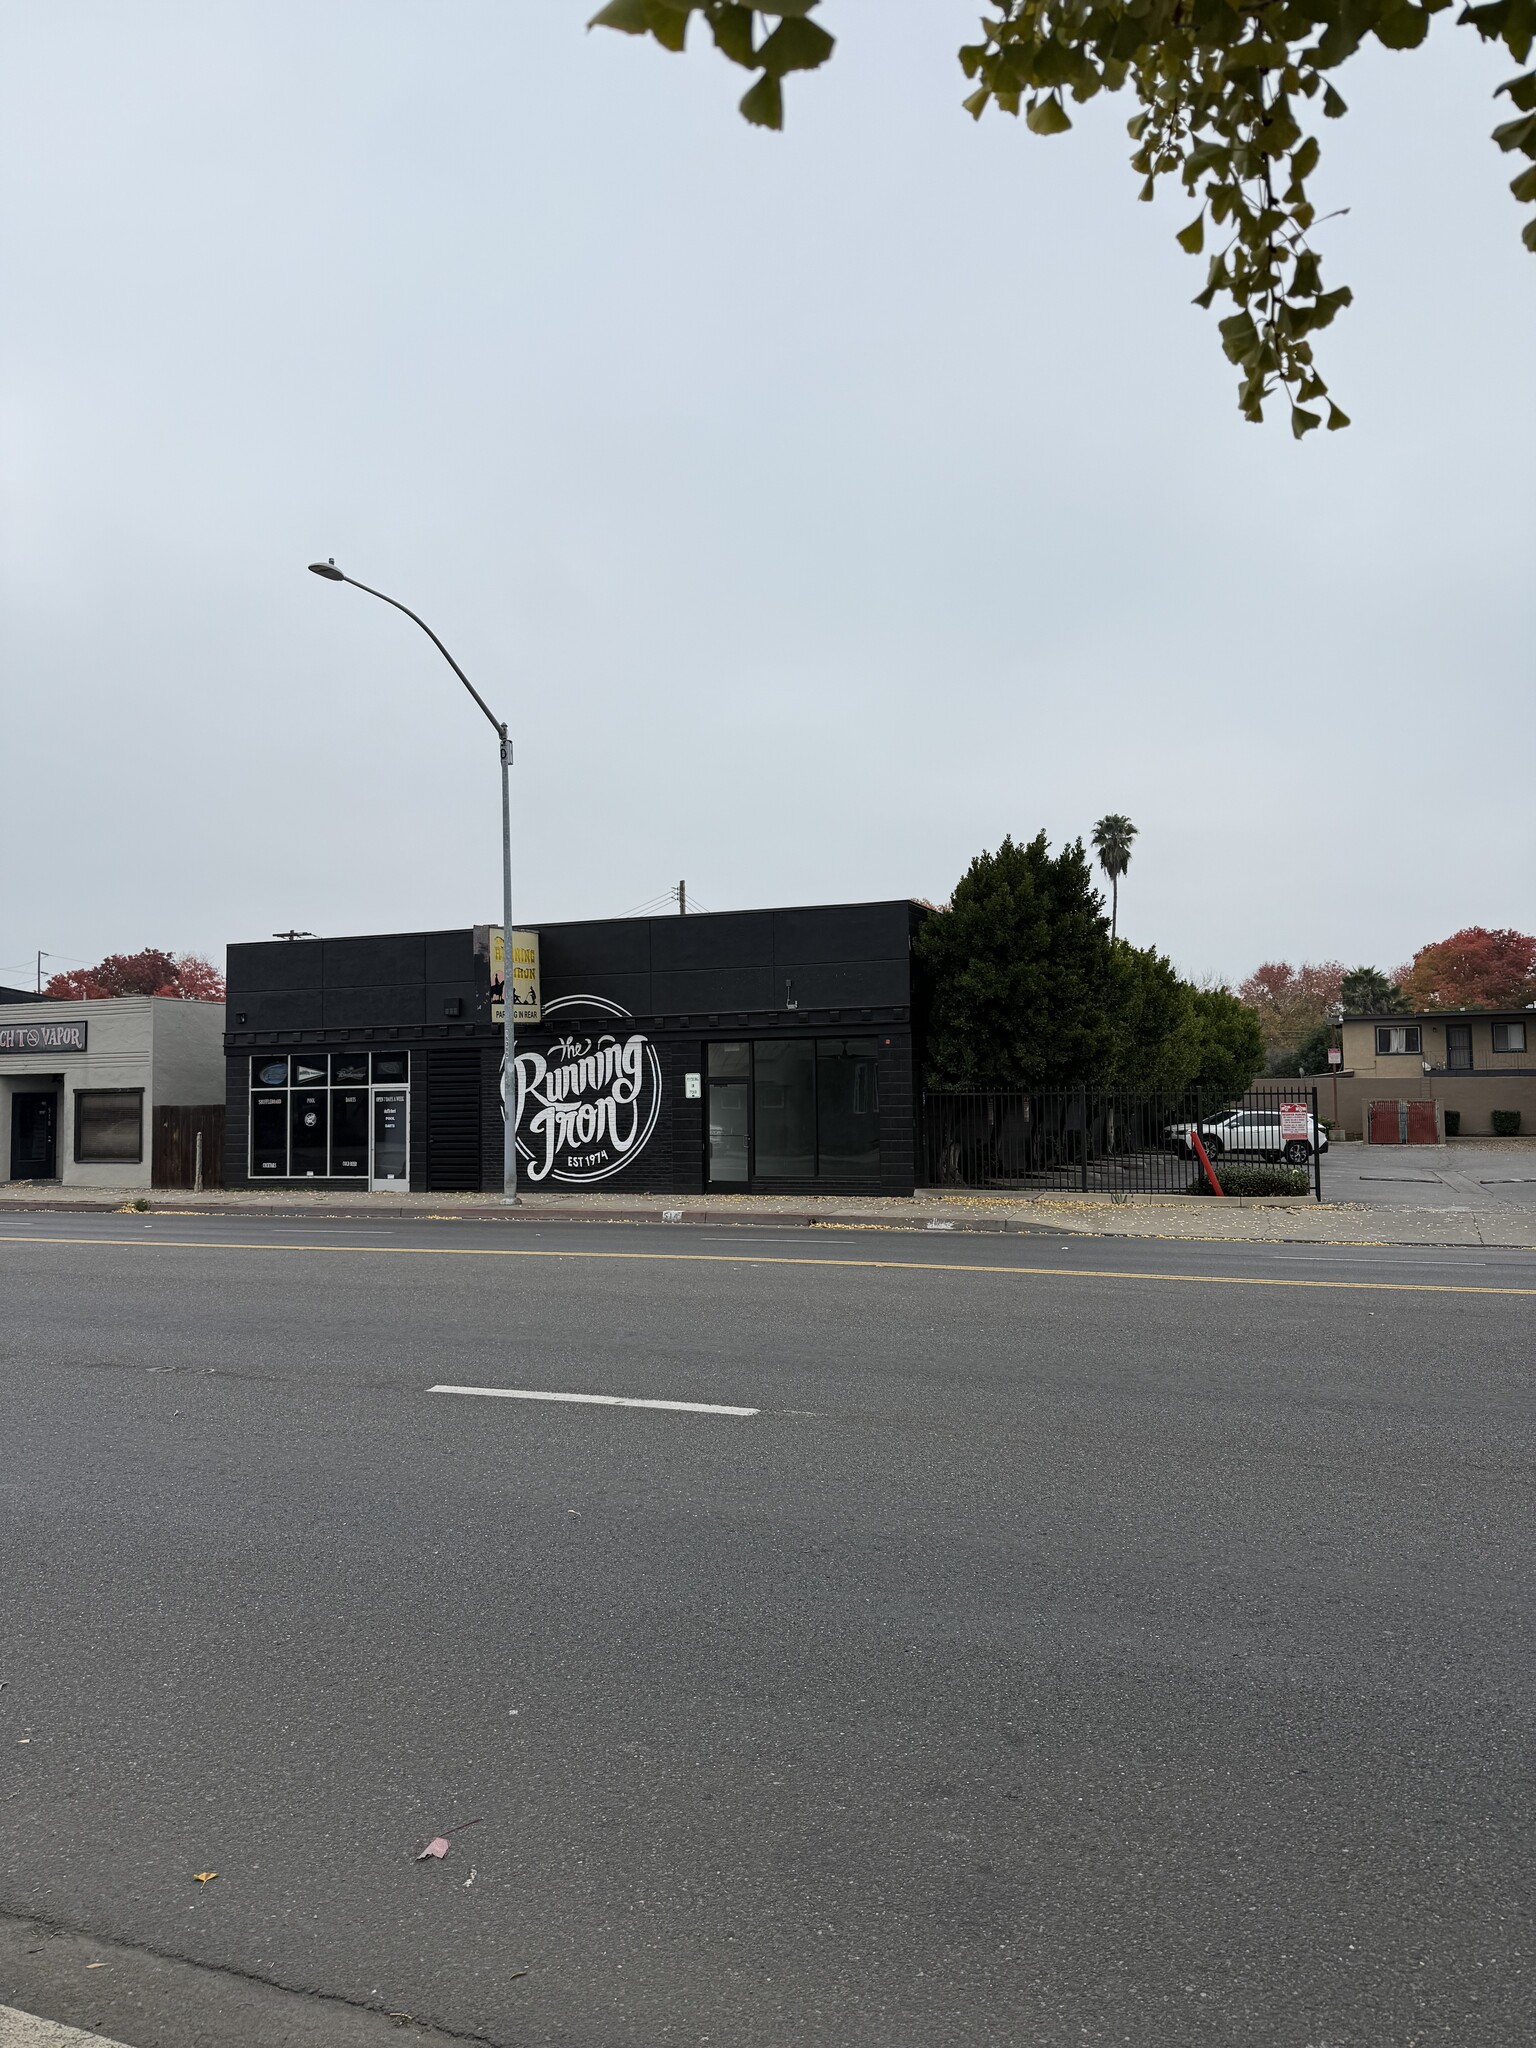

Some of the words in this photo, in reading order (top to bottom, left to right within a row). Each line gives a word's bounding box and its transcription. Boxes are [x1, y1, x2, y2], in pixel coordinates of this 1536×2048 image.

[518, 1010, 524, 1019] IN
[524, 1010, 538, 1019] REAR
[41, 1026, 82, 1048] VAPOR
[501, 1034, 648, 1132] Running
[567, 1156, 584, 1168] EST
[585, 1149, 609, 1167] 1974
